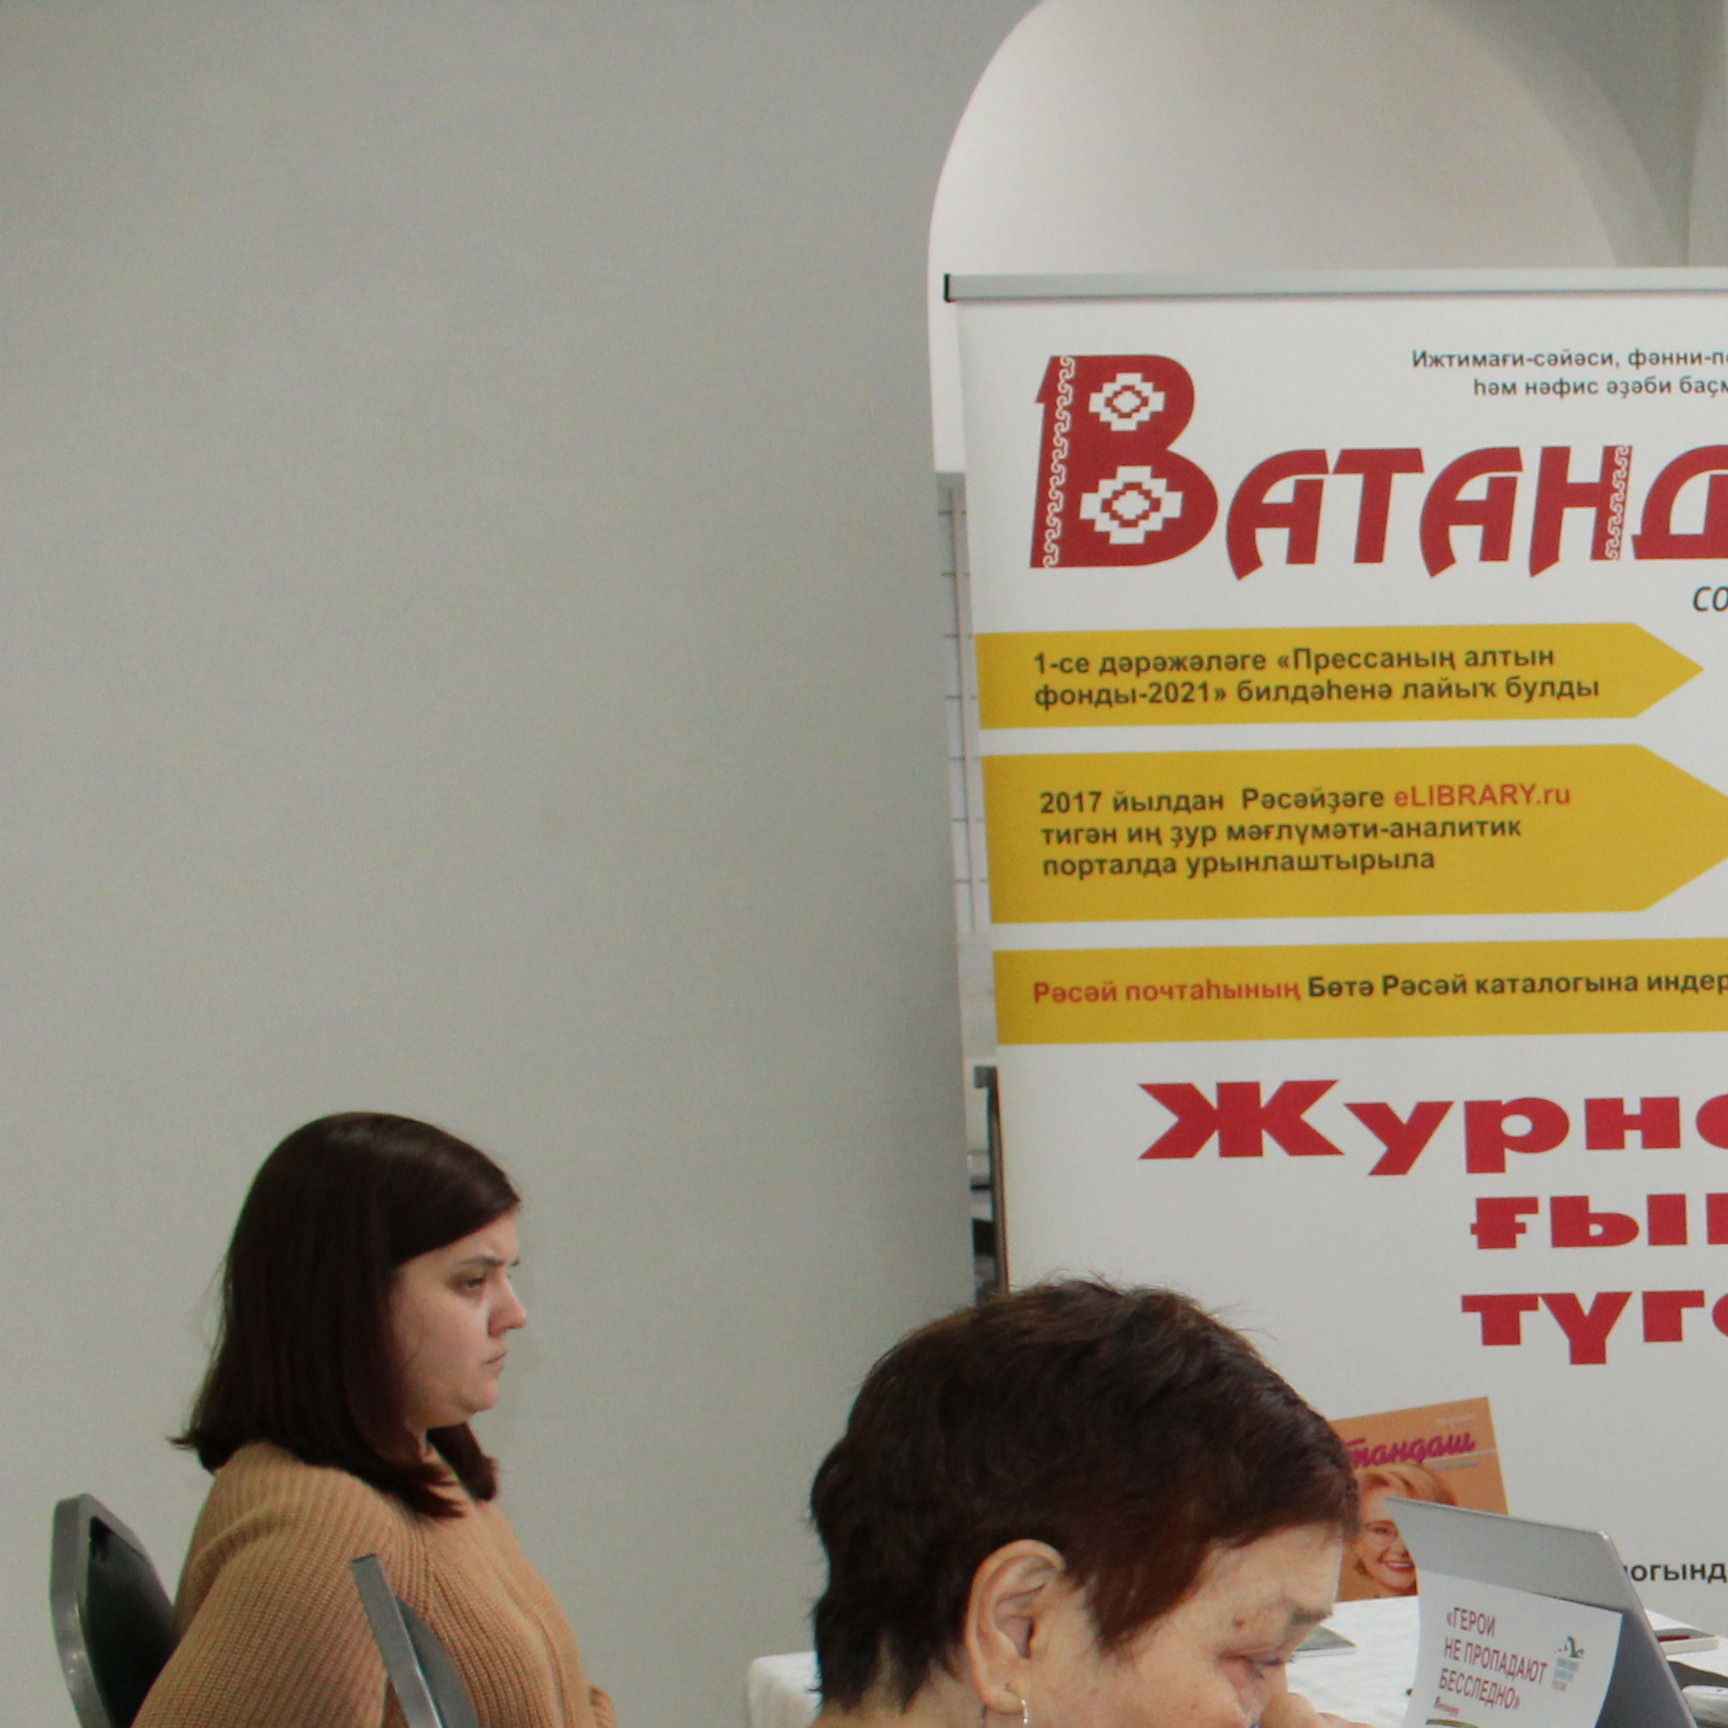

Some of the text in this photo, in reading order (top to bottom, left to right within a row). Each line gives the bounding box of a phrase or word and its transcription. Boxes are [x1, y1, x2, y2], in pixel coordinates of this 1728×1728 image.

[1411, 349, 1620, 368] Ижтимағи-сәйәси,
[1473, 378, 1517, 396] һәм
[1524, 377, 1599, 399] нәфис
[1606, 375, 1672, 399] әҙәби
[1034, 646, 1554, 678] 1-се дәрәжәләге «Прессаның алтын
[1034, 674, 1599, 712] фонды-2021» билдәһенә лайыҡ булды
[1040, 783, 1571, 815] 2017 йылдан Рәсәйҙәге eLIBRARY.ru
[1040, 819, 1521, 849] тигән иң ҙур мәғлүмәти-аналитик
[1042, 851, 1435, 881] порталда урынлаштырыла
[1033, 981, 1117, 1004] Рәсәй
[1125, 979, 1301, 1002] почтаһының
[1307, 975, 1375, 998] Бөтә
[1381, 974, 1467, 996] Рәсәй
[1474, 975, 1639, 995] каталогына
[1446, 1607, 1497, 1637] «ГЕРОИ
[1444, 1636, 1461, 1661] НЕ
[1463, 1641, 1548, 1684] ПРОПАДАЮТ
[1438, 1668, 1521, 1710] БЕССЛЕДНО»
